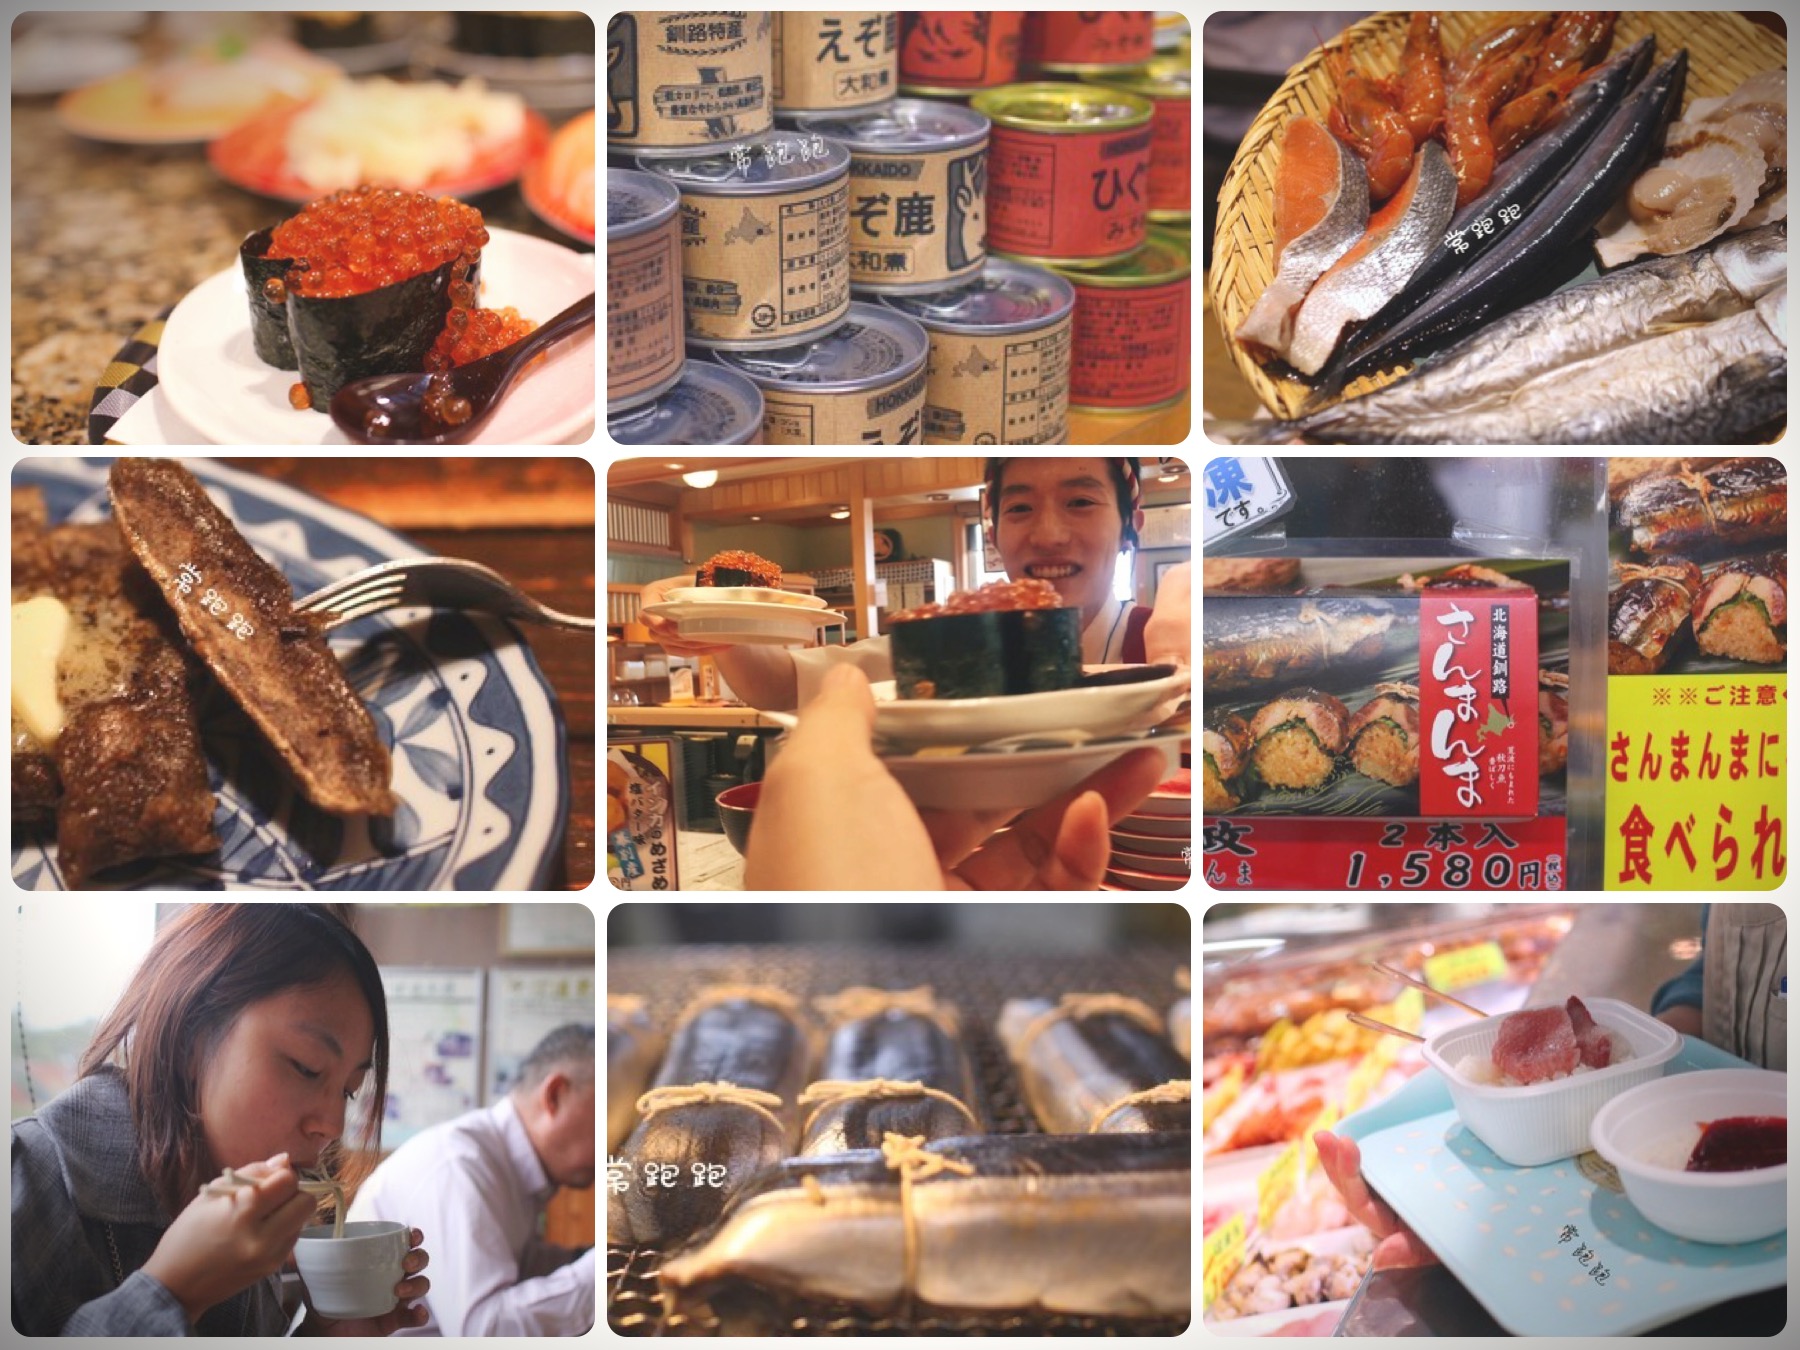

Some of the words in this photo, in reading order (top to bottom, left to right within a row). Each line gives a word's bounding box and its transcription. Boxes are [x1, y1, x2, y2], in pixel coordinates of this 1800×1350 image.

[665, 20, 743, 43] 釧路特産
[1492, 607, 1508, 694] 北海道釧路
[1431, 602, 1486, 808] さんまんま
[1611, 729, 1780, 783] さんまんまに
[1380, 821, 1519, 851] 2本入
[1619, 804, 1787, 885] 食べられ
[1347, 851, 1540, 889] 1,580円
